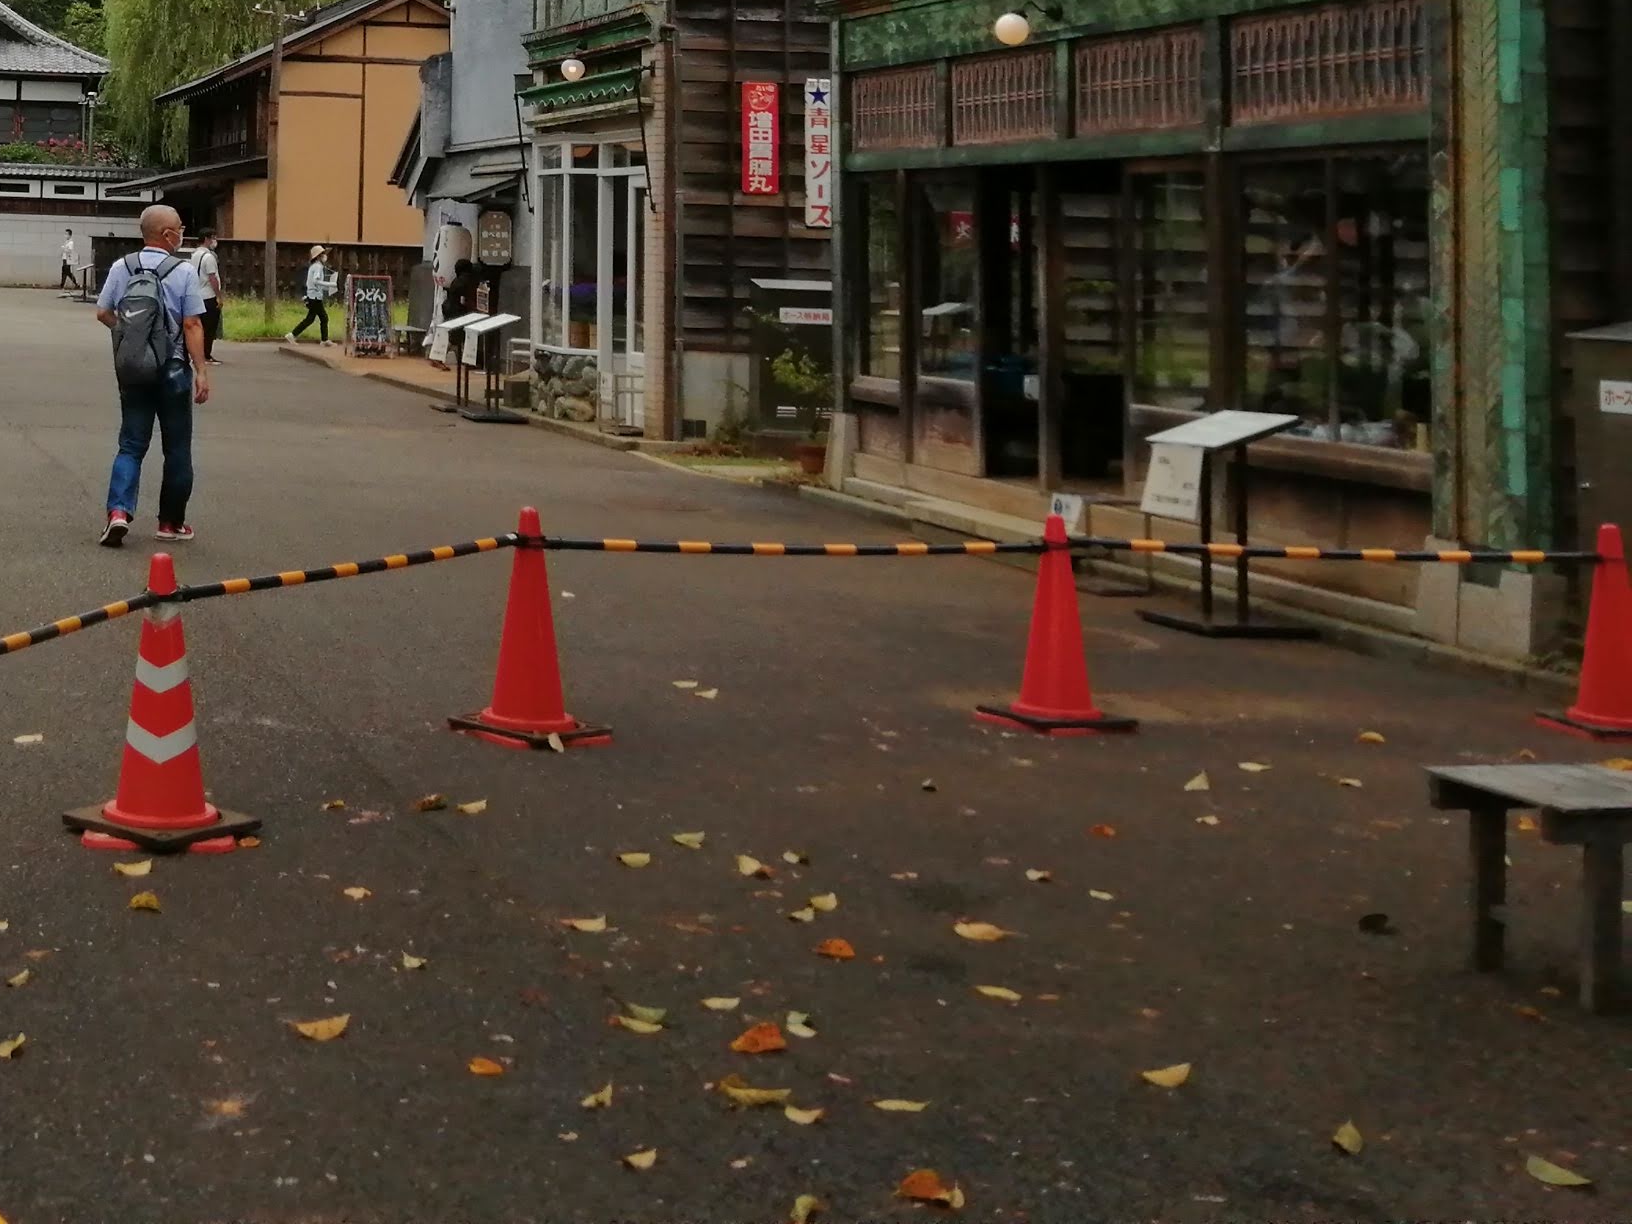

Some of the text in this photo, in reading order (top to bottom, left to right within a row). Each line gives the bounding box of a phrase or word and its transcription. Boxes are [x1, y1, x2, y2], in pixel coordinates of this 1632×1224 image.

[808, 107, 832, 225] 青星ソース
[355, 287, 387, 303] うどん
